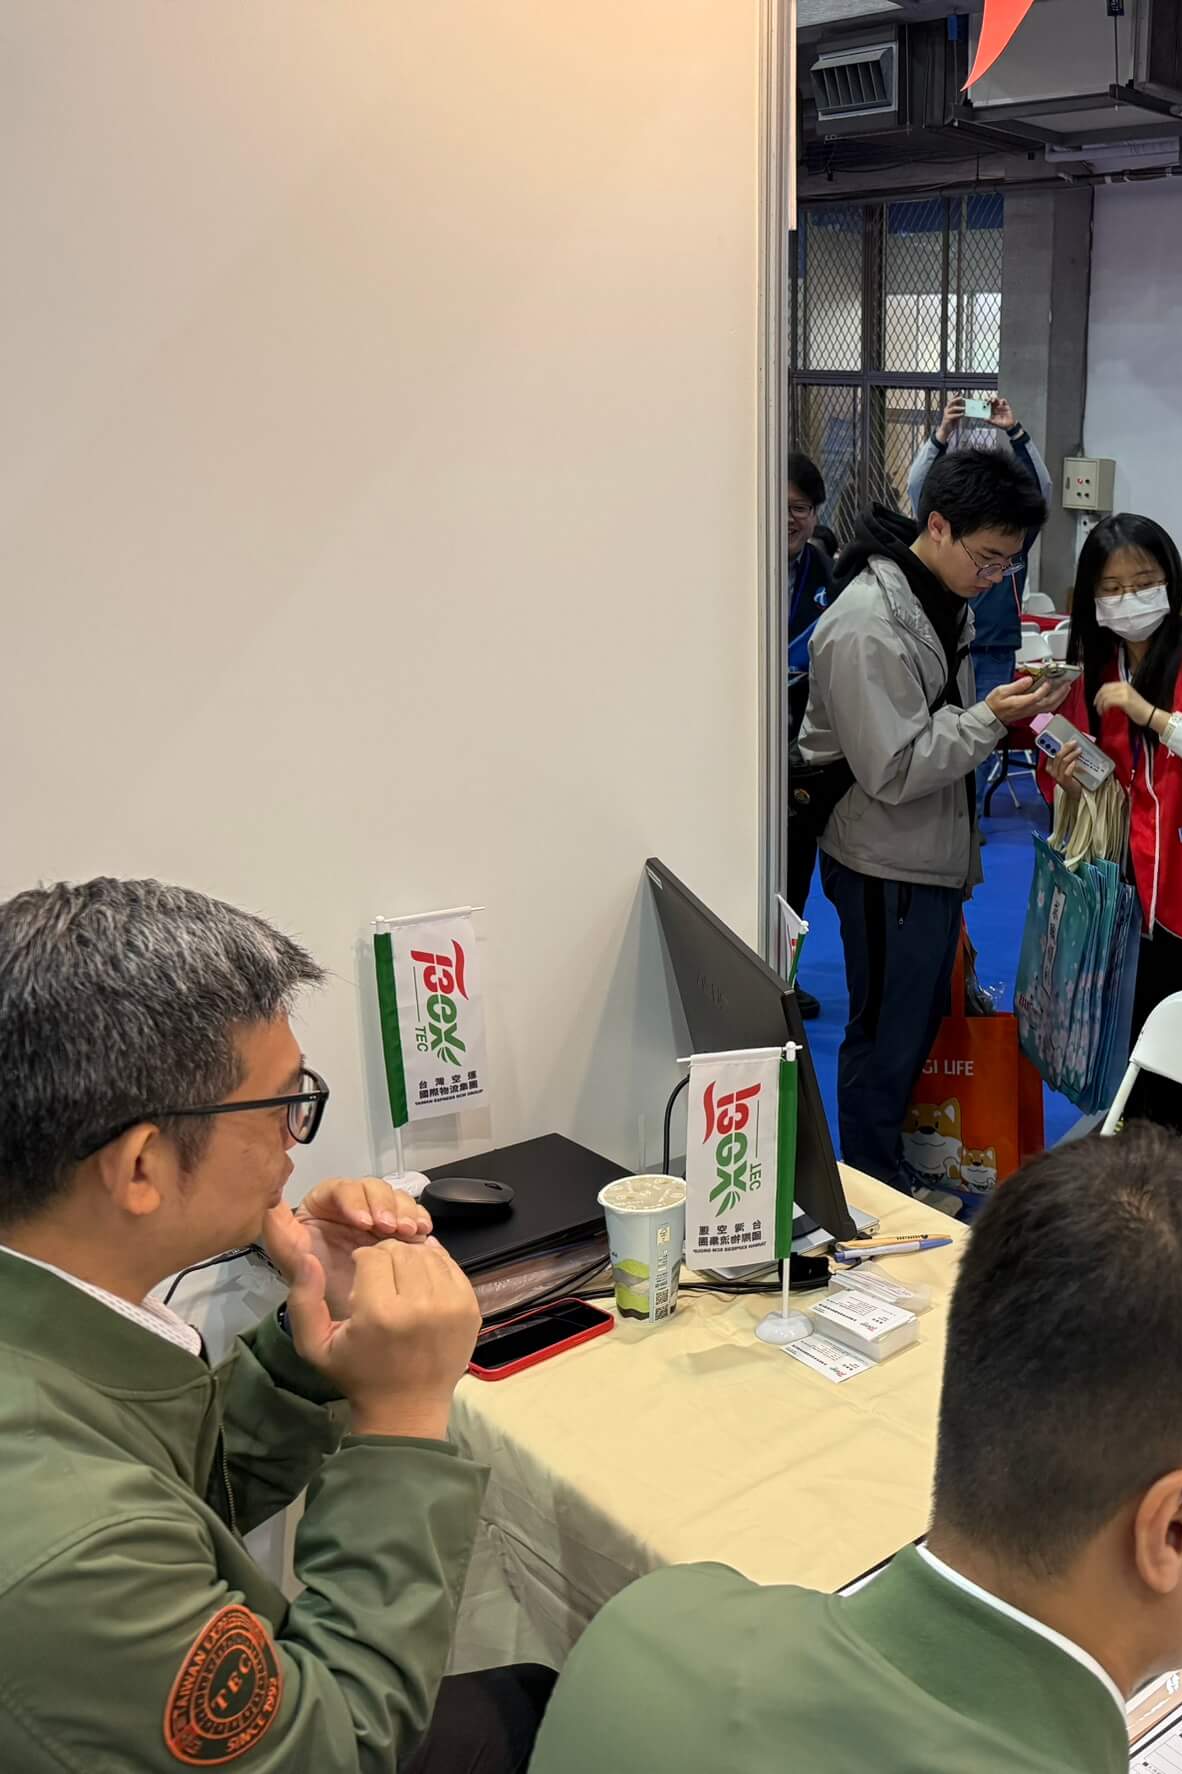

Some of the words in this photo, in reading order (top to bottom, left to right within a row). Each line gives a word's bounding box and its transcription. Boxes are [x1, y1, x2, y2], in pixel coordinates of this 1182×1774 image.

[415, 1025, 429, 1052] TEC
[944, 1060, 974, 1076] LIFE
[418, 1070, 477, 1089] 台灣空運
[419, 1080, 478, 1099] 國際物流集團
[212, 1653, 251, 1711] TEC
